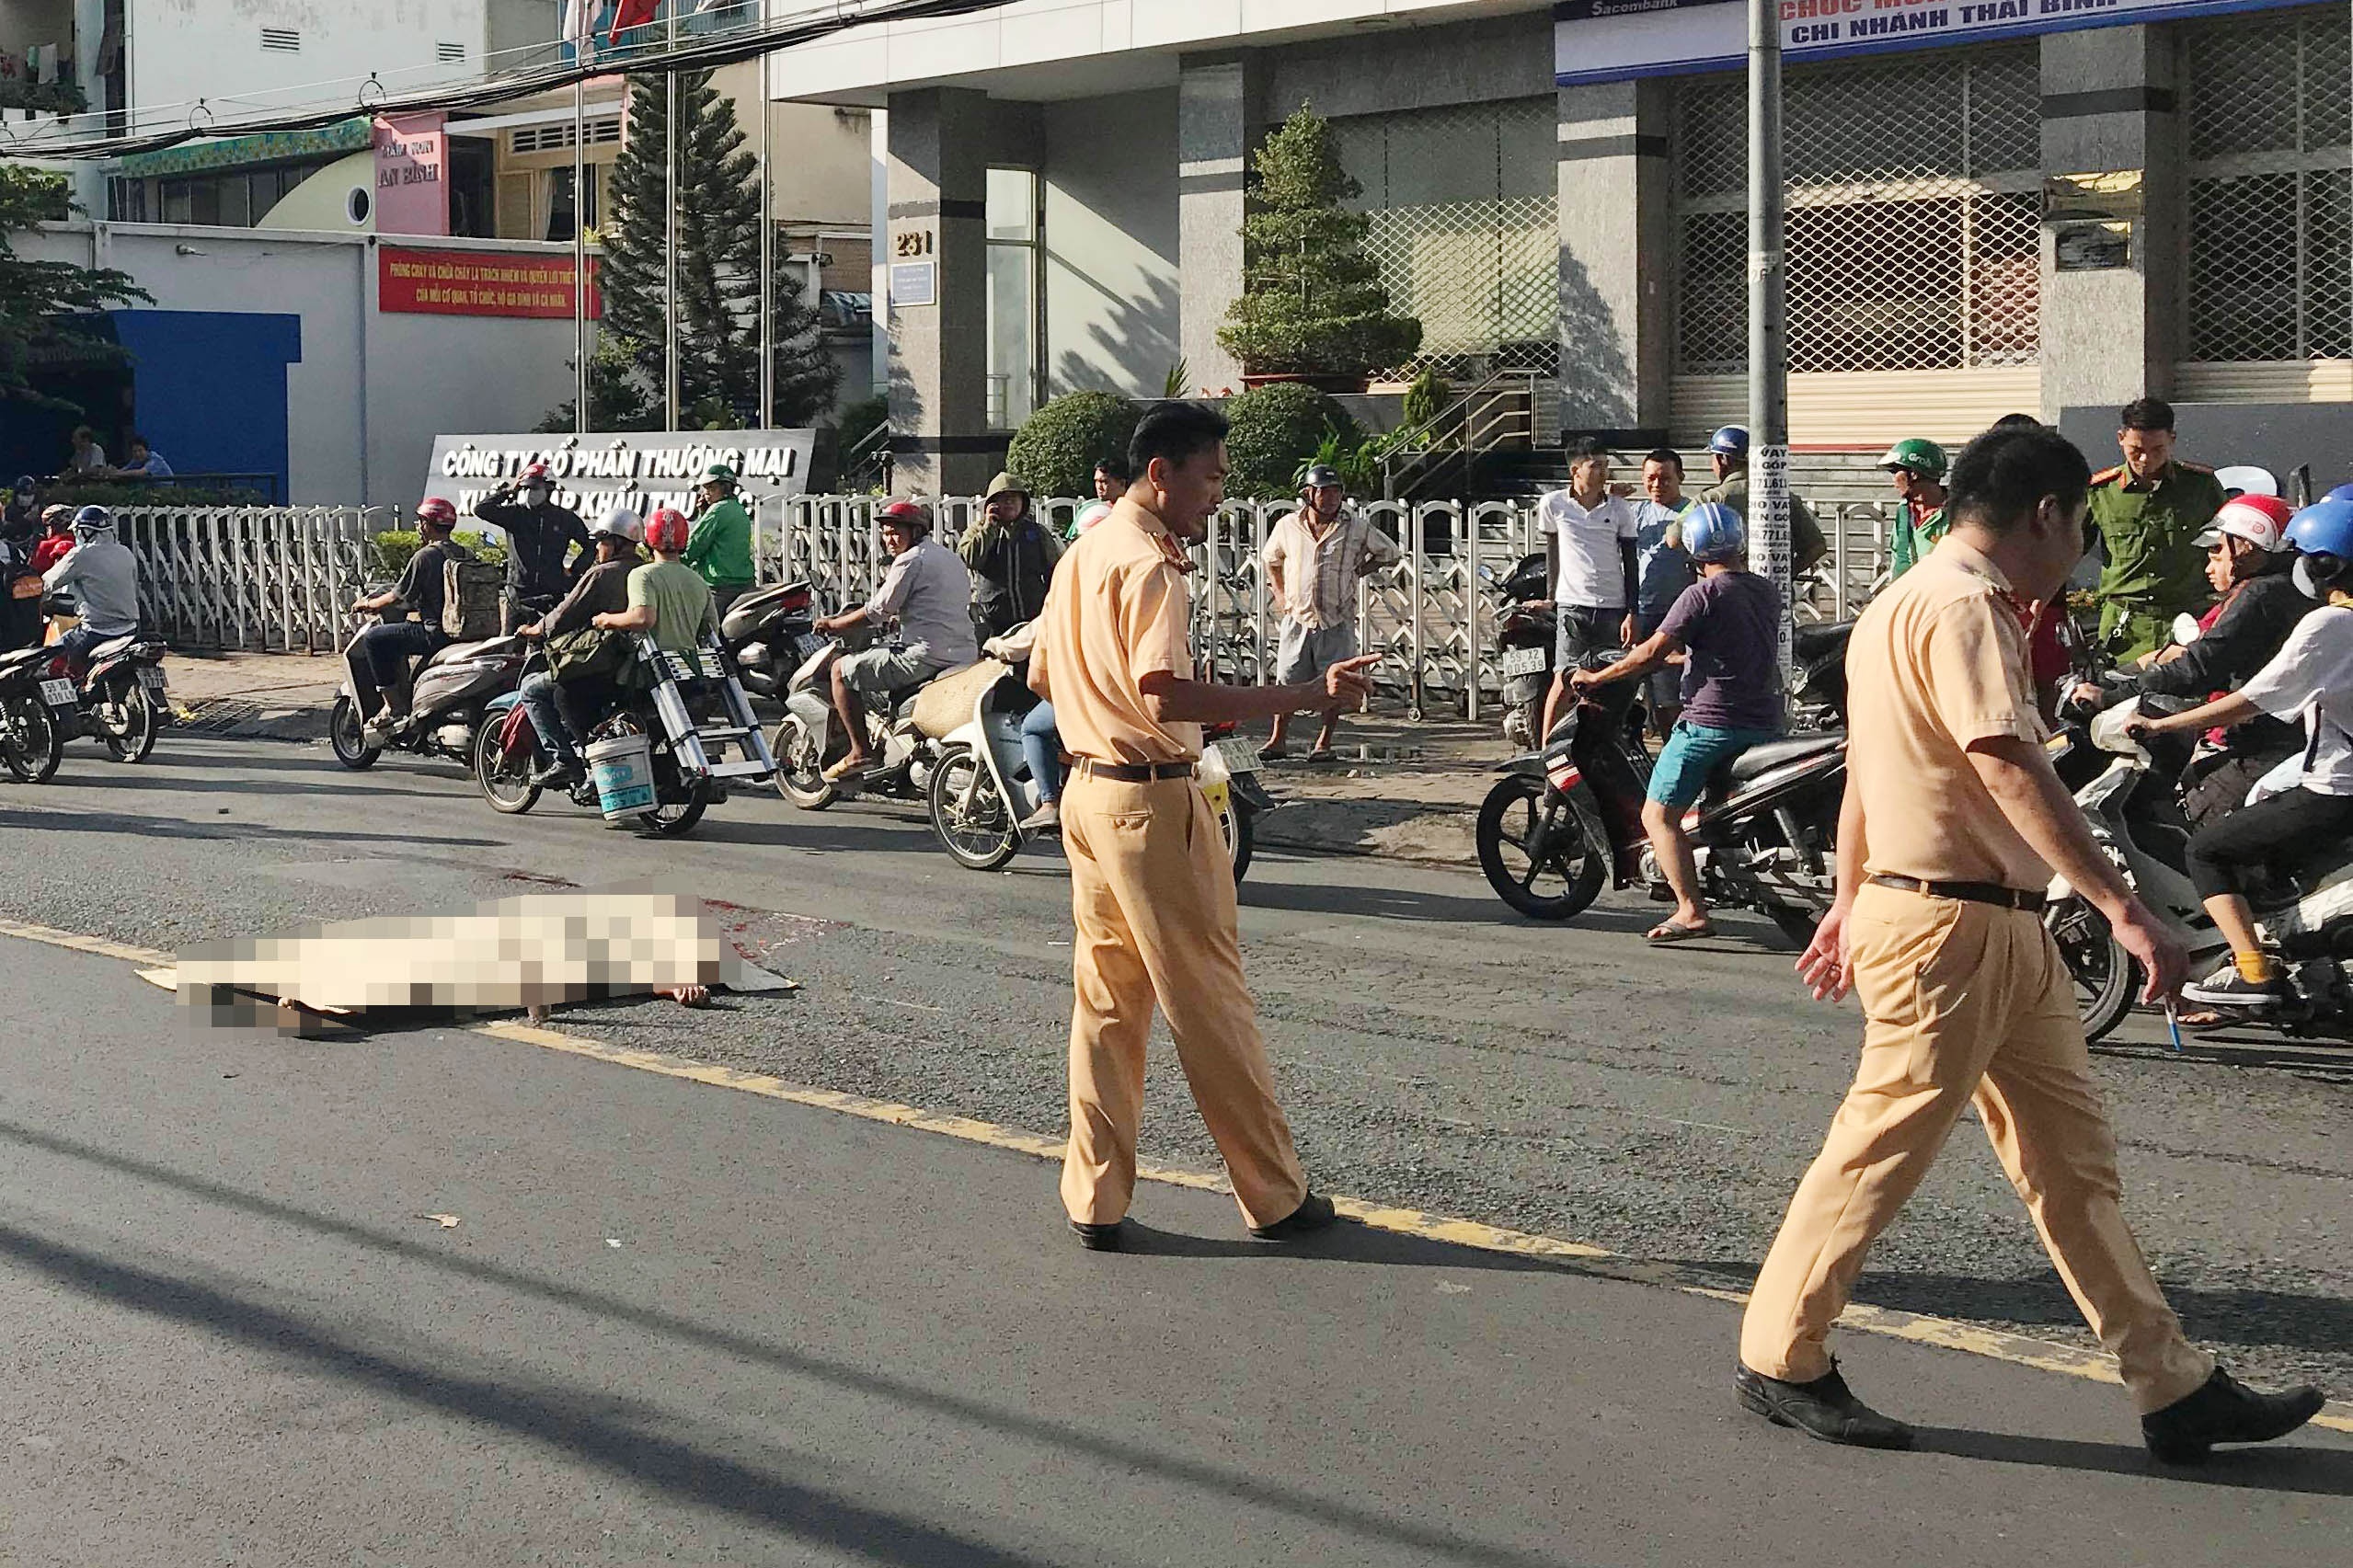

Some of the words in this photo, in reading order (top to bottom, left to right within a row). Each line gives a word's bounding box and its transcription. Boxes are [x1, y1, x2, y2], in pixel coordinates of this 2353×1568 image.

[1792, 23, 1839, 43] CHI
[1850, 10, 1947, 37] NHÁNH
[898, 230, 933, 257] 231
[442, 442, 500, 477] CÔNG
[572, 438, 637, 476] PHẦN
[642, 443, 742, 477] THƯƠNG
[743, 447, 793, 485] MẠI
[1762, 461, 1786, 469] GÓP
[1909, 453, 1931, 467] Grab
